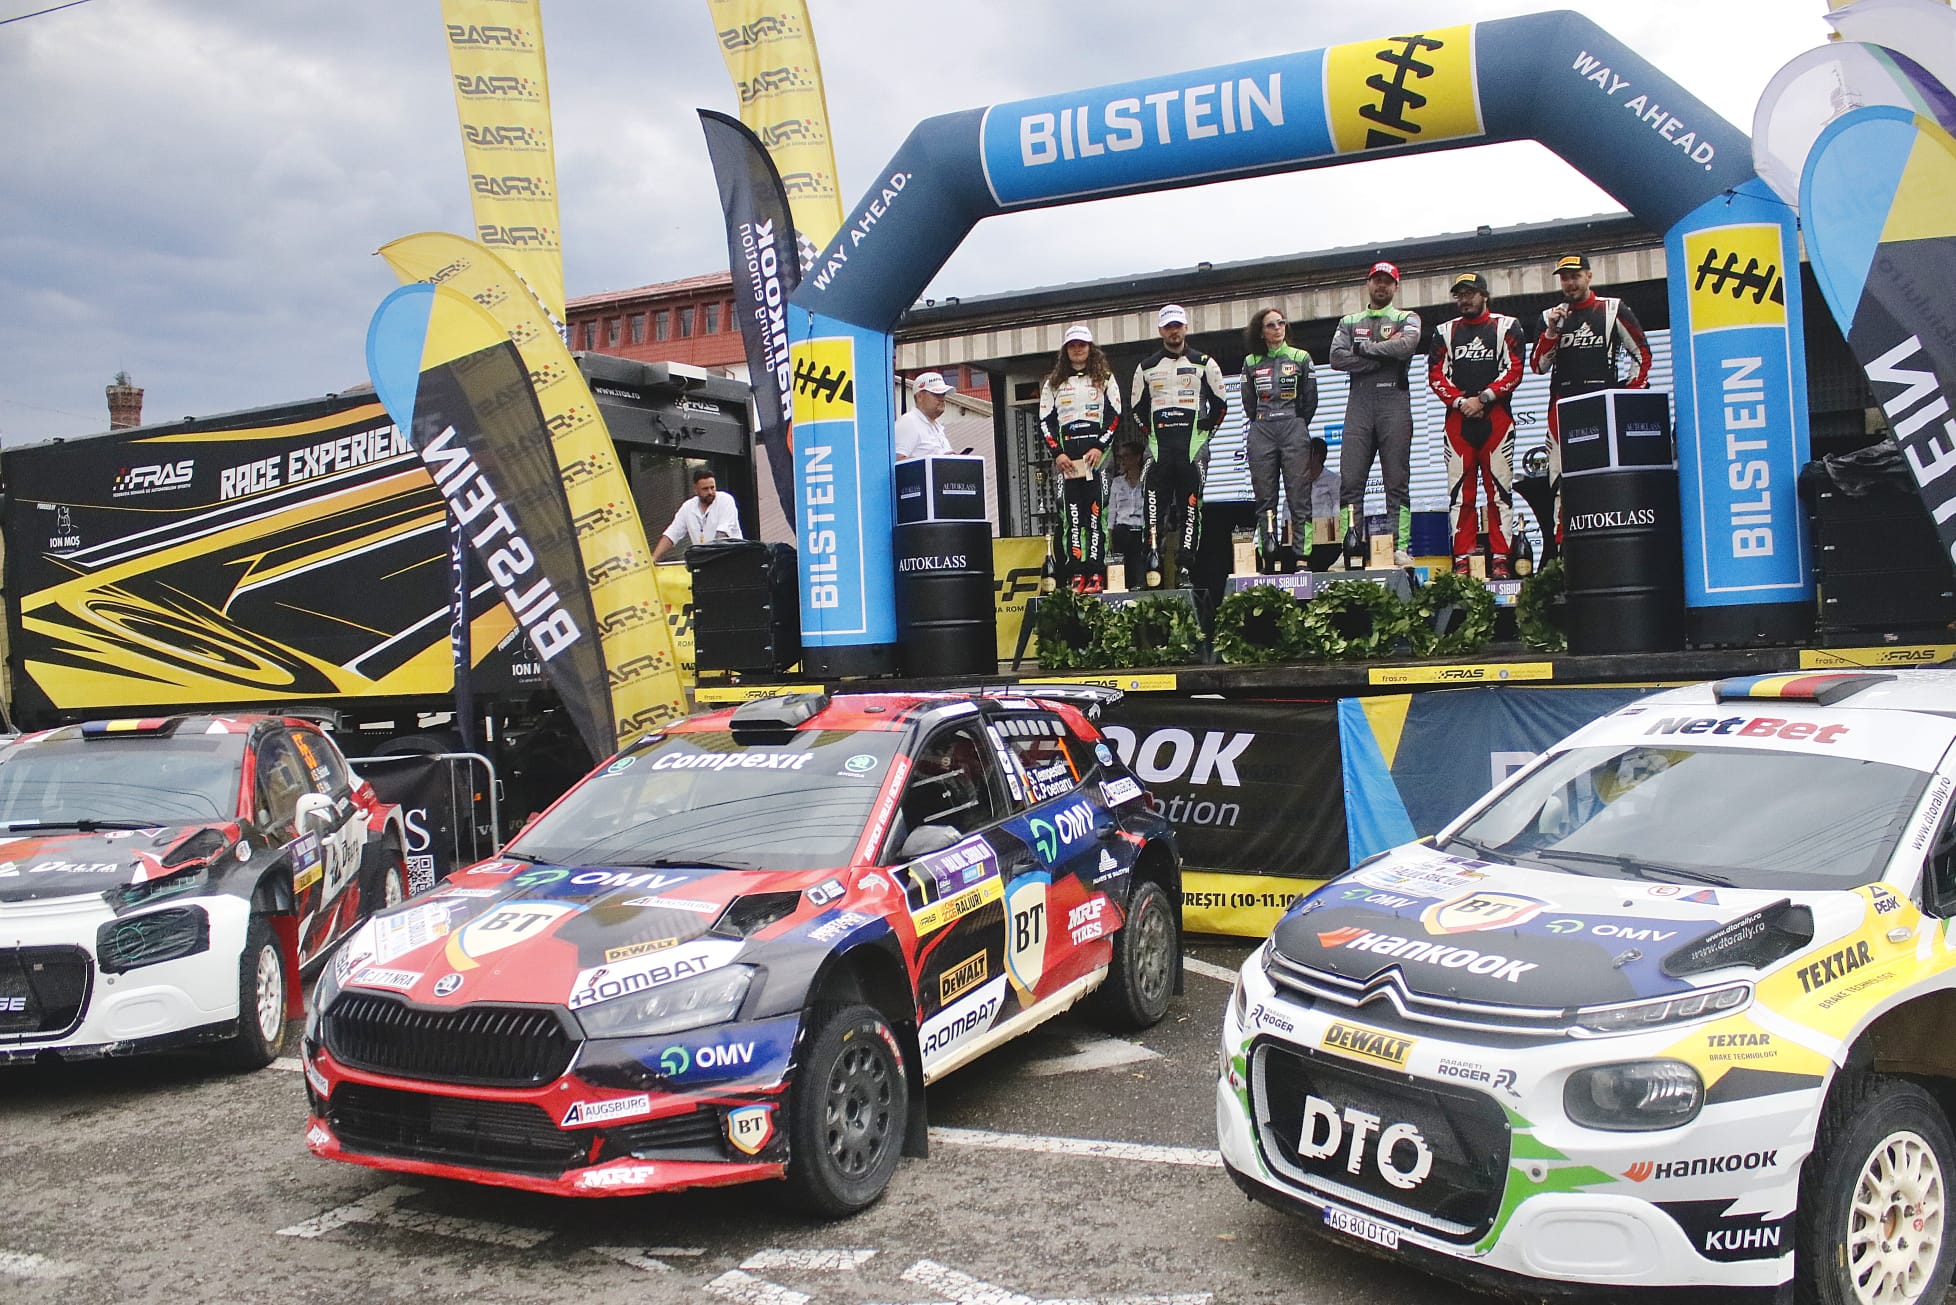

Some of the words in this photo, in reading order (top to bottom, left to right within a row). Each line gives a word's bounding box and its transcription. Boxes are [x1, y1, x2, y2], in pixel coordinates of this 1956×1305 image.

[1019, 71, 1285, 167] BILSTEIN
[1571, 49, 1630, 96] WAY
[1624, 93, 1716, 171] AHEAD.
[813, 244, 848, 291] WAY
[851, 173, 912, 248] AHEAD.
[221, 455, 281, 501] RACE
[288, 424, 414, 483] EXPERIEN
[1720, 355, 1774, 558] BILSTEIN
[128, 459, 194, 489] FRAS
[804, 446, 839, 609] BILSTEIN
[1569, 509, 1655, 531] AUTOKLASS
[898, 555, 967, 572] AUTOKLASS
[1888, 649, 1936, 660] FRAS
[1445, 669, 1485, 679] FRAS
[1643, 717, 1850, 744] NetBet
[652, 752, 814, 771] Compexit
[1054, 801, 1094, 844] OMV
[1912, 777, 1951, 851] www.dtorally.ro
[570, 871, 688, 889] OMV
[956, 893, 983, 915] RALIURI
[1363, 893, 1418, 909] OMV
[1455, 900, 1517, 917] BT
[1874, 896, 1901, 915] PEAK
[478, 912, 553, 933] BT
[1068, 897, 1106, 931] MRF
[1015, 903, 1044, 953] BT
[1591, 926, 1679, 942] OMV
[1706, 912, 1762, 943] www.dtorally.ro
[1690, 921, 1765, 960] www.dtorally.ro
[571, 955, 710, 1006] ROMBAT
[1819, 988, 1851, 1010] BRAKE
[922, 997, 997, 1057] ROMBAT
[1262, 1013, 1295, 1033] ROGER
[1707, 1033, 1771, 1048] TEXTAR
[695, 1042, 755, 1068] OMV
[1440, 1058, 1483, 1071] PARAPETI
[1709, 1053, 1732, 1062] BRAKE
[1733, 1050, 1778, 1061] TECHNOLOGY
[1437, 1064, 1491, 1084] ROGER
[585, 1098, 647, 1117] AUGSBURG
[737, 1116, 764, 1135] BT
[1298, 1095, 1433, 1189] DTO
[582, 1166, 655, 1186] MRF
[1331, 1211, 1348, 1230] AG
[1349, 1215, 1366, 1236] 80
[1366, 1219, 1397, 1246] DTO
[1705, 1227, 1780, 1251] KUHN
